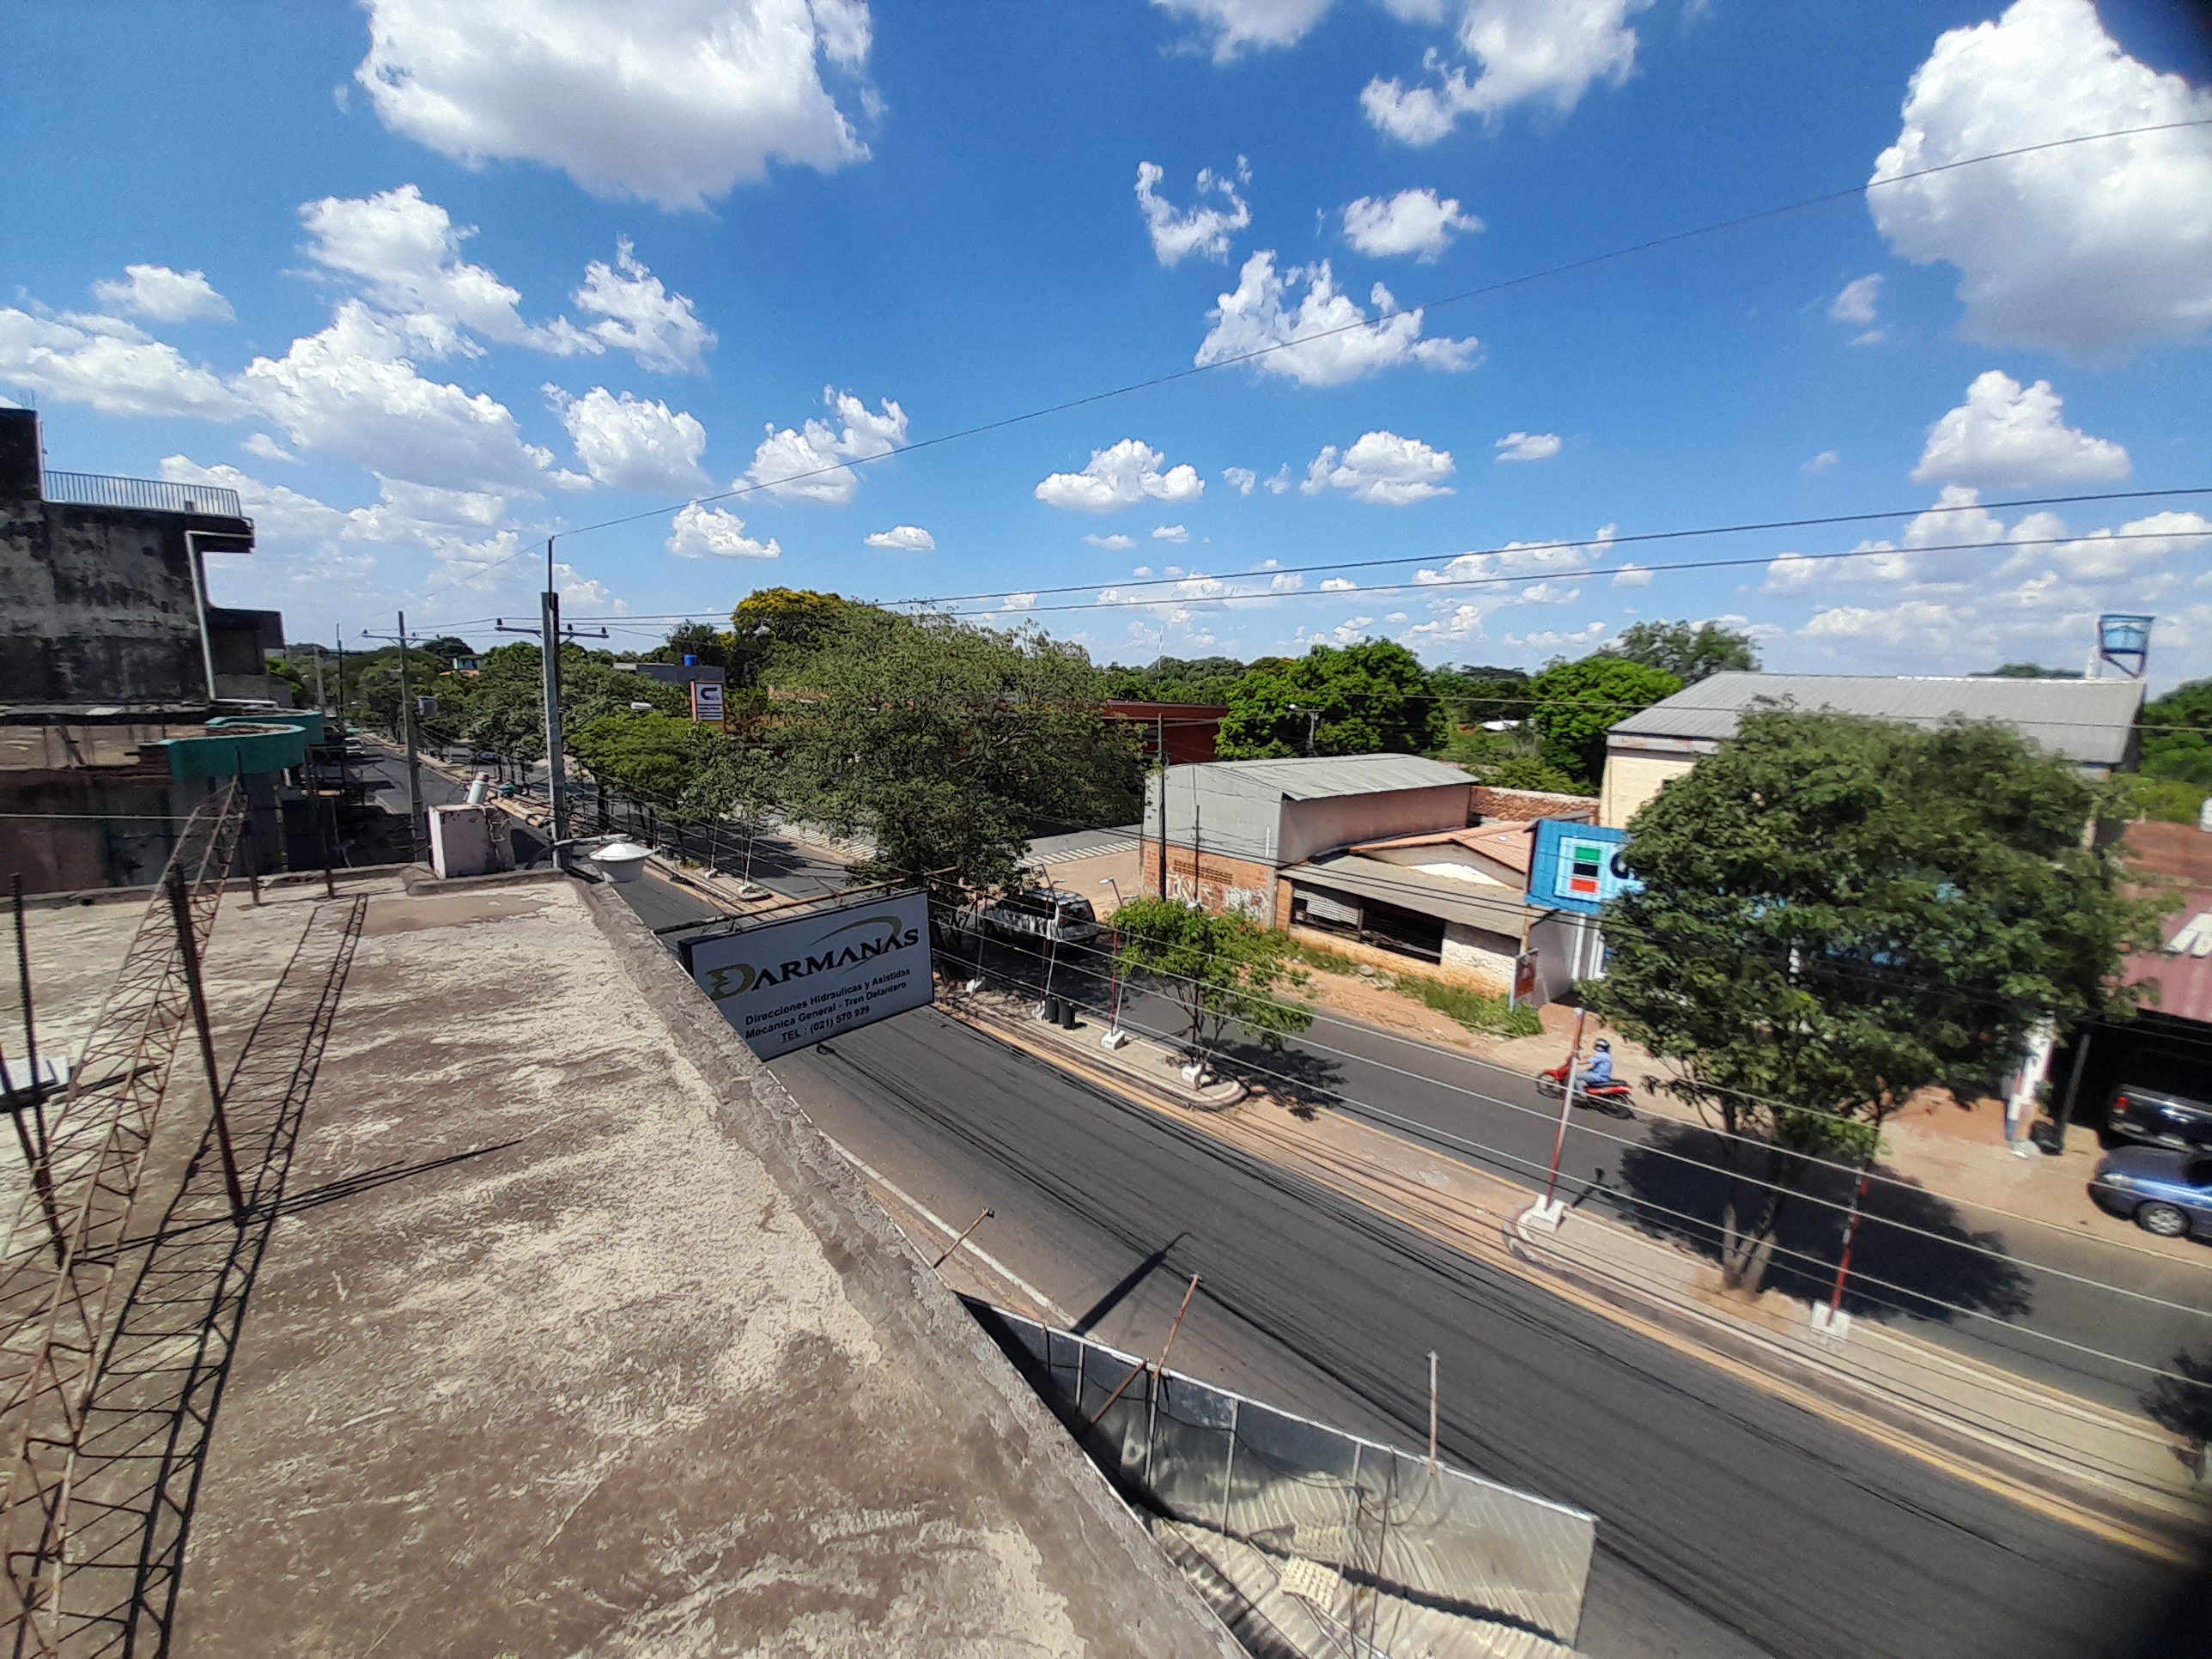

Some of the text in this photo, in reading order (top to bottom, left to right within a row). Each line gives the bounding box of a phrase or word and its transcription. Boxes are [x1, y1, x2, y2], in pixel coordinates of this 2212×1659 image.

[706, 928, 919, 1000] DARMANAS
[745, 969, 911, 1025] Direcciones Hidraulicas y Asistidas
[798, 1003, 836, 1022] General
[844, 994, 865, 1006] Tren
[866, 981, 907, 1000] Delantero
[781, 1029, 800, 1042] TEL
[810, 1018, 834, 1035] (021)
